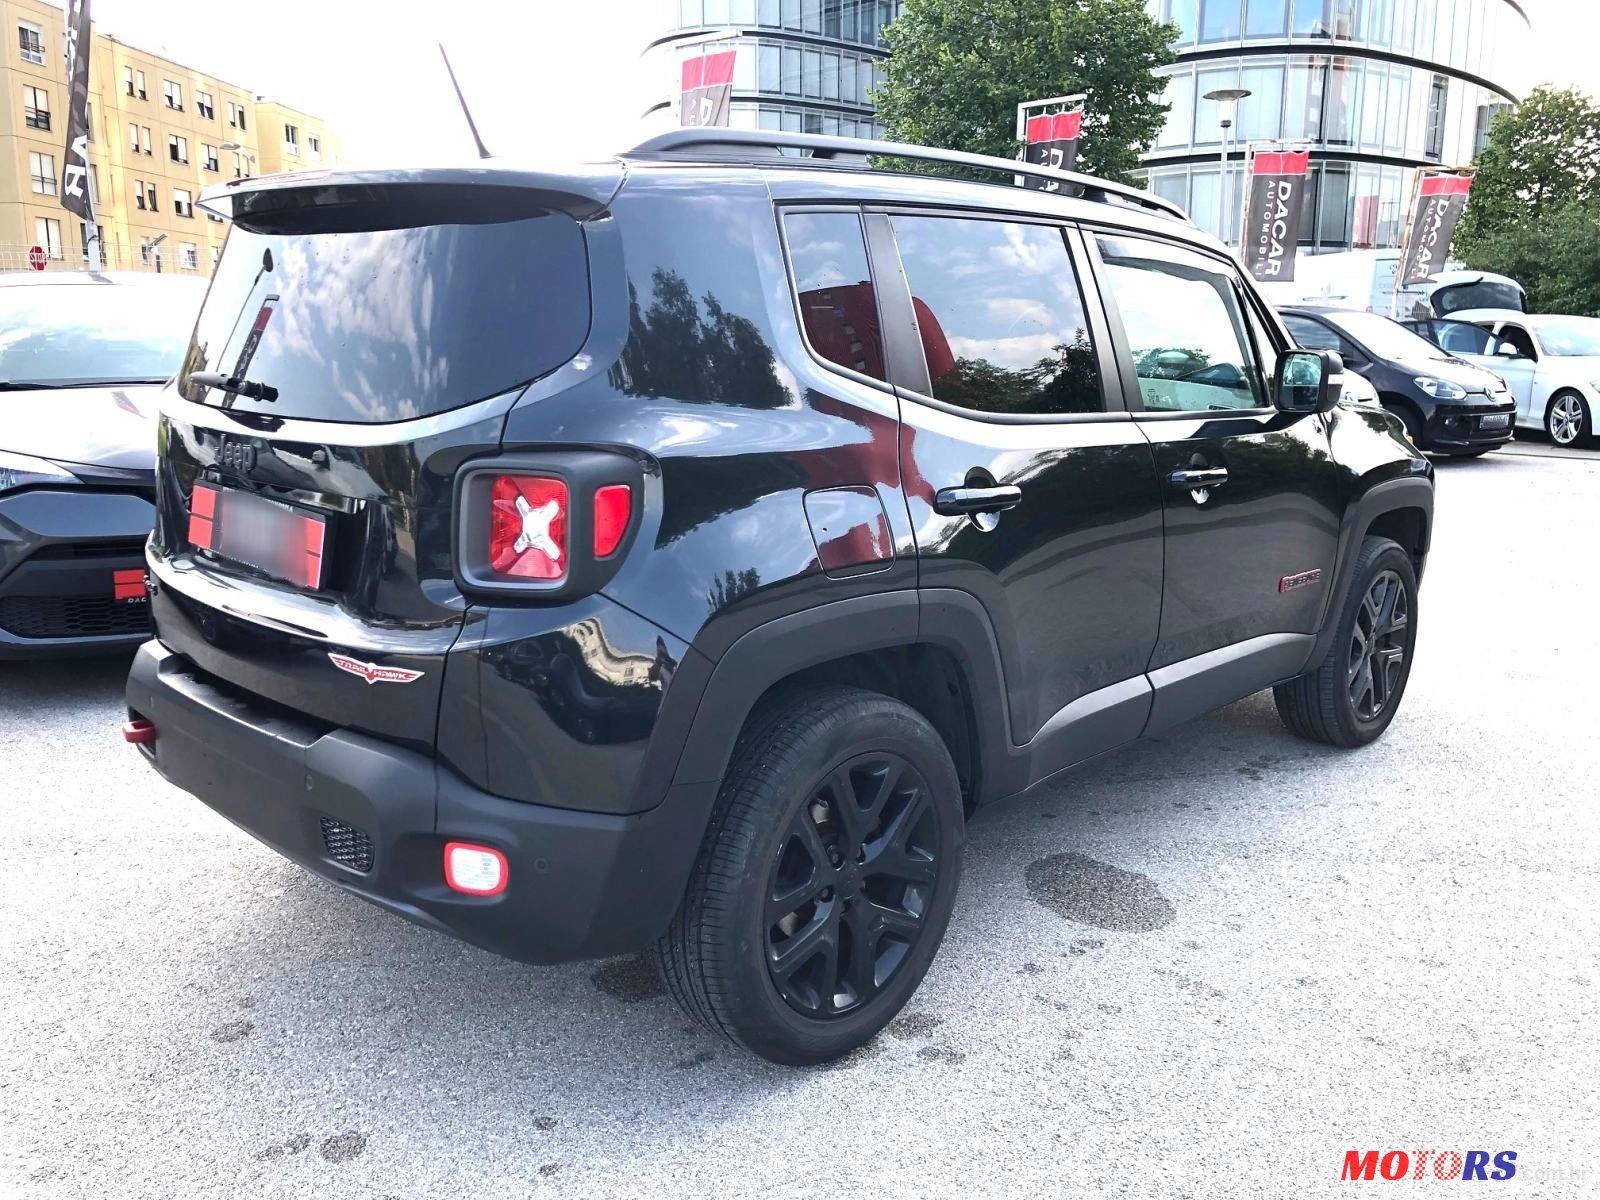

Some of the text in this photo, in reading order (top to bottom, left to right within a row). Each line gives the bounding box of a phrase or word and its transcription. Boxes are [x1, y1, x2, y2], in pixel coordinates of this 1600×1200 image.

[1255, 181, 1276, 276] AUTOMOBILI
[1265, 181, 1292, 276] DACAR
[1417, 199, 1450, 278] DACAR
[214, 433, 257, 474] Jeep
